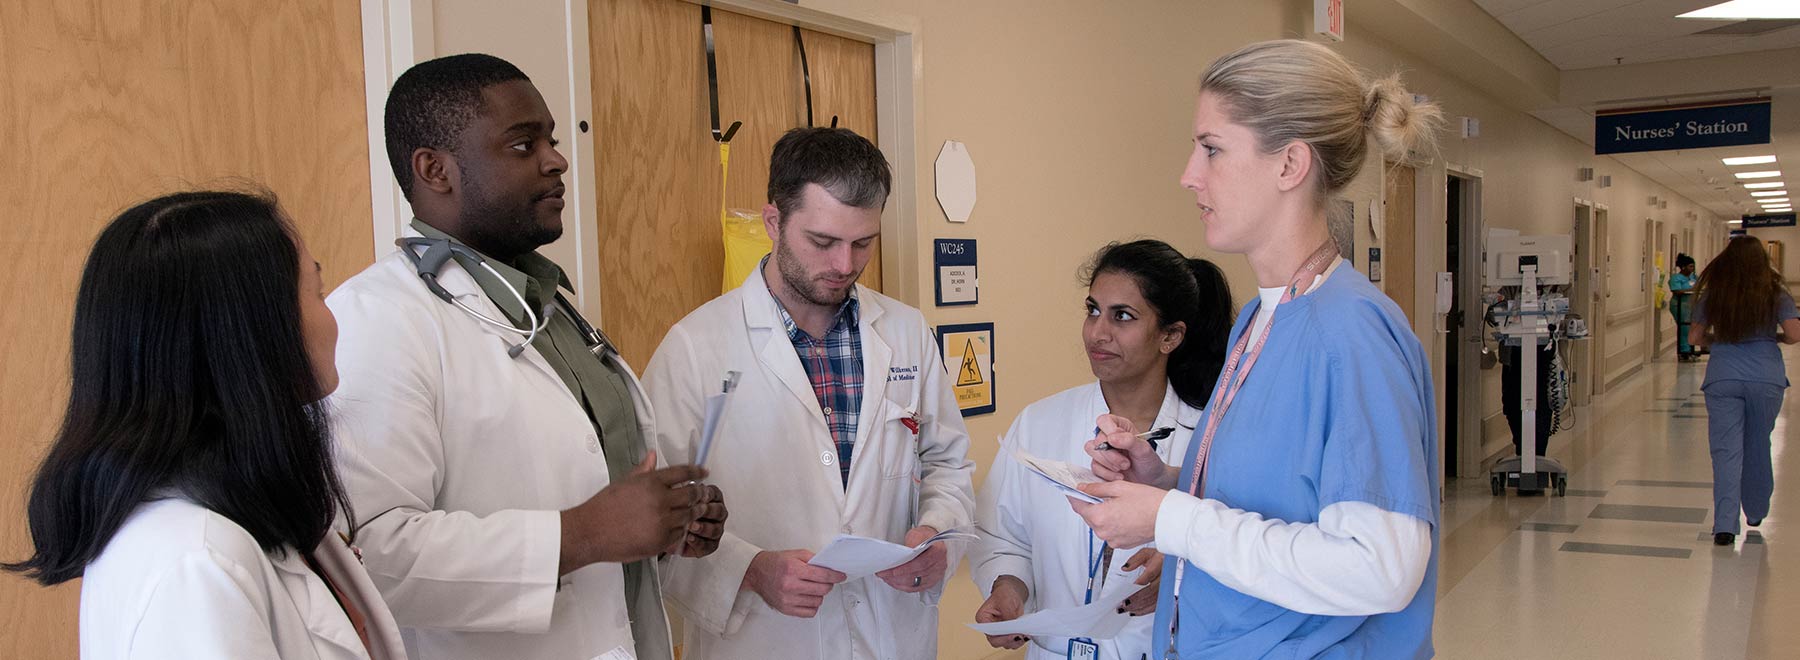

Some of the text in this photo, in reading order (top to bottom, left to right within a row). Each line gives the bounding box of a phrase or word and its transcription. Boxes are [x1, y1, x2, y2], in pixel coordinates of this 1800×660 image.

[1615, 120, 1748, 140] Nurses' Station
[940, 242, 965, 255] WC245
